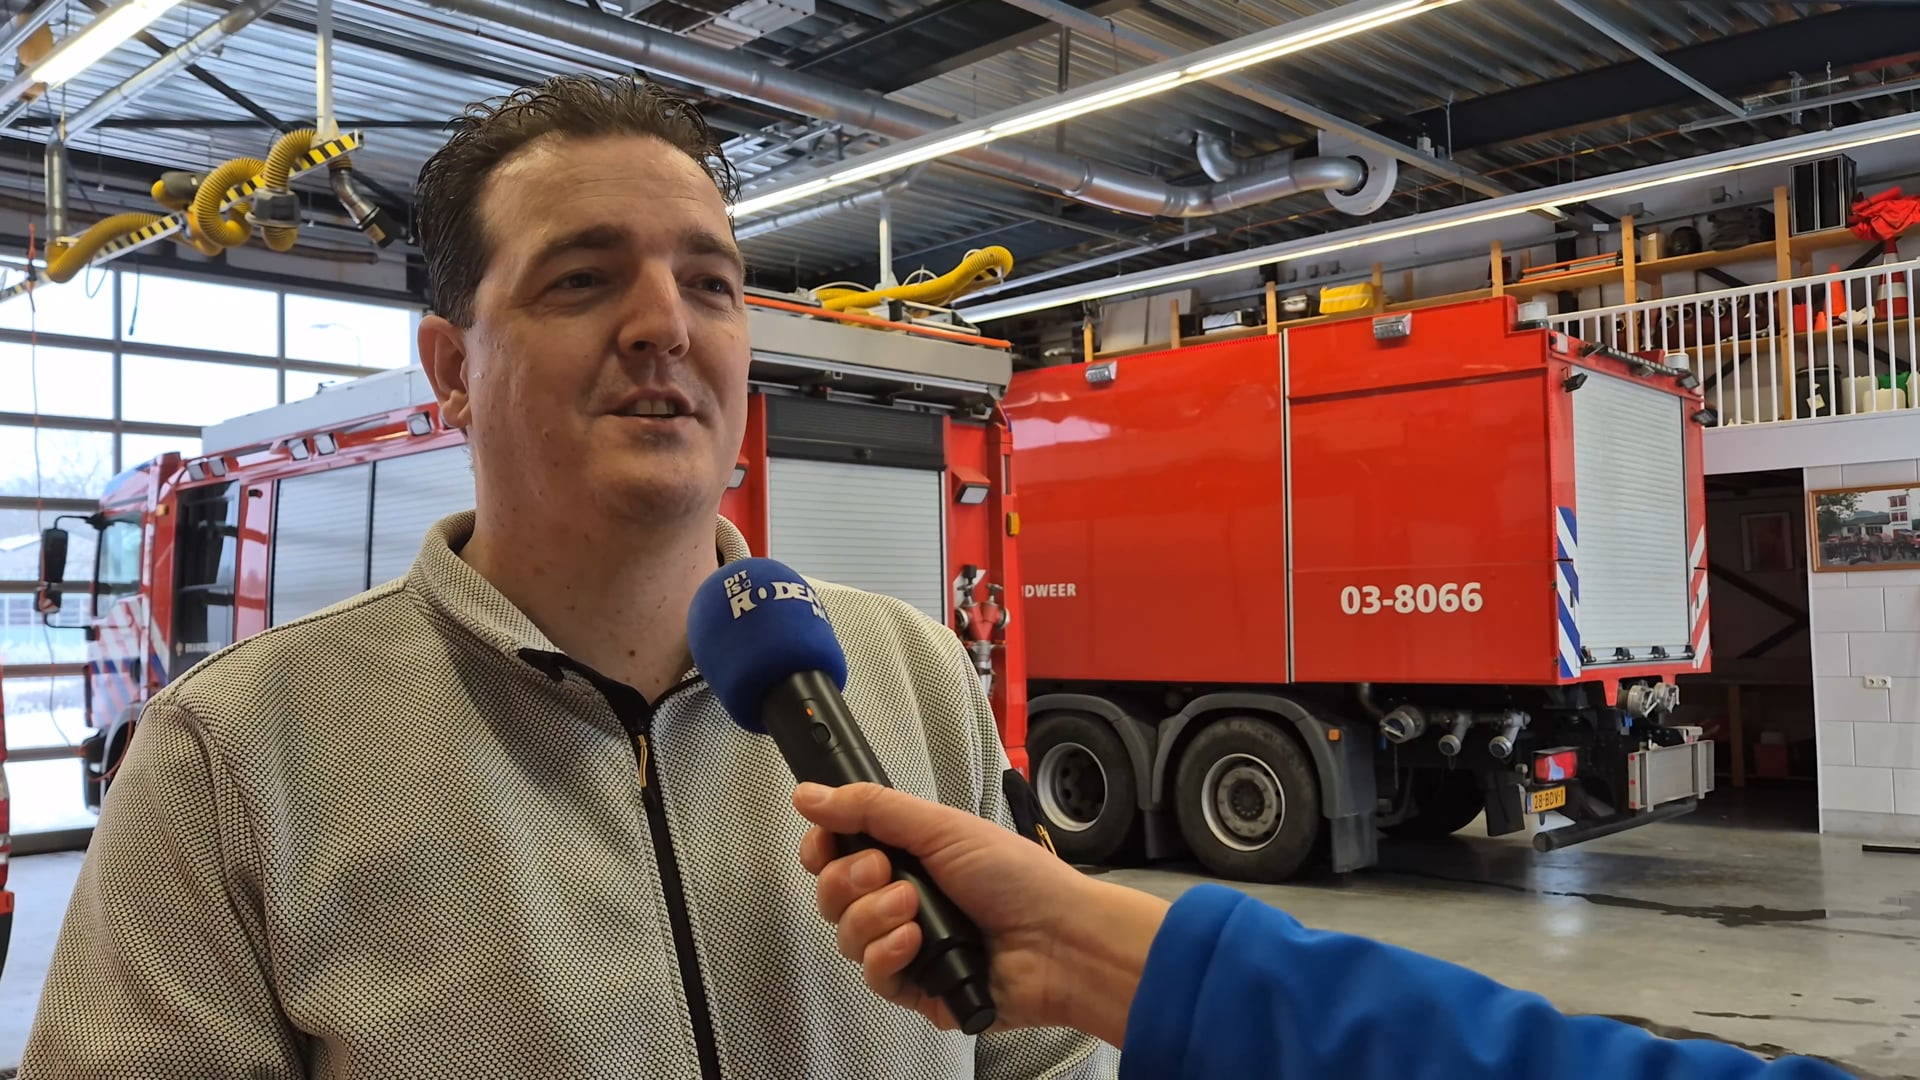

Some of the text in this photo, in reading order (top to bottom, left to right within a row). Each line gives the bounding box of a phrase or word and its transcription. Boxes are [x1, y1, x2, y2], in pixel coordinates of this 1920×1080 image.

[724, 570, 747, 588] DIT
[727, 583, 742, 599] IS
[1021, 583, 1077, 598] DWEER
[1340, 582, 1483, 615] 03-8066
